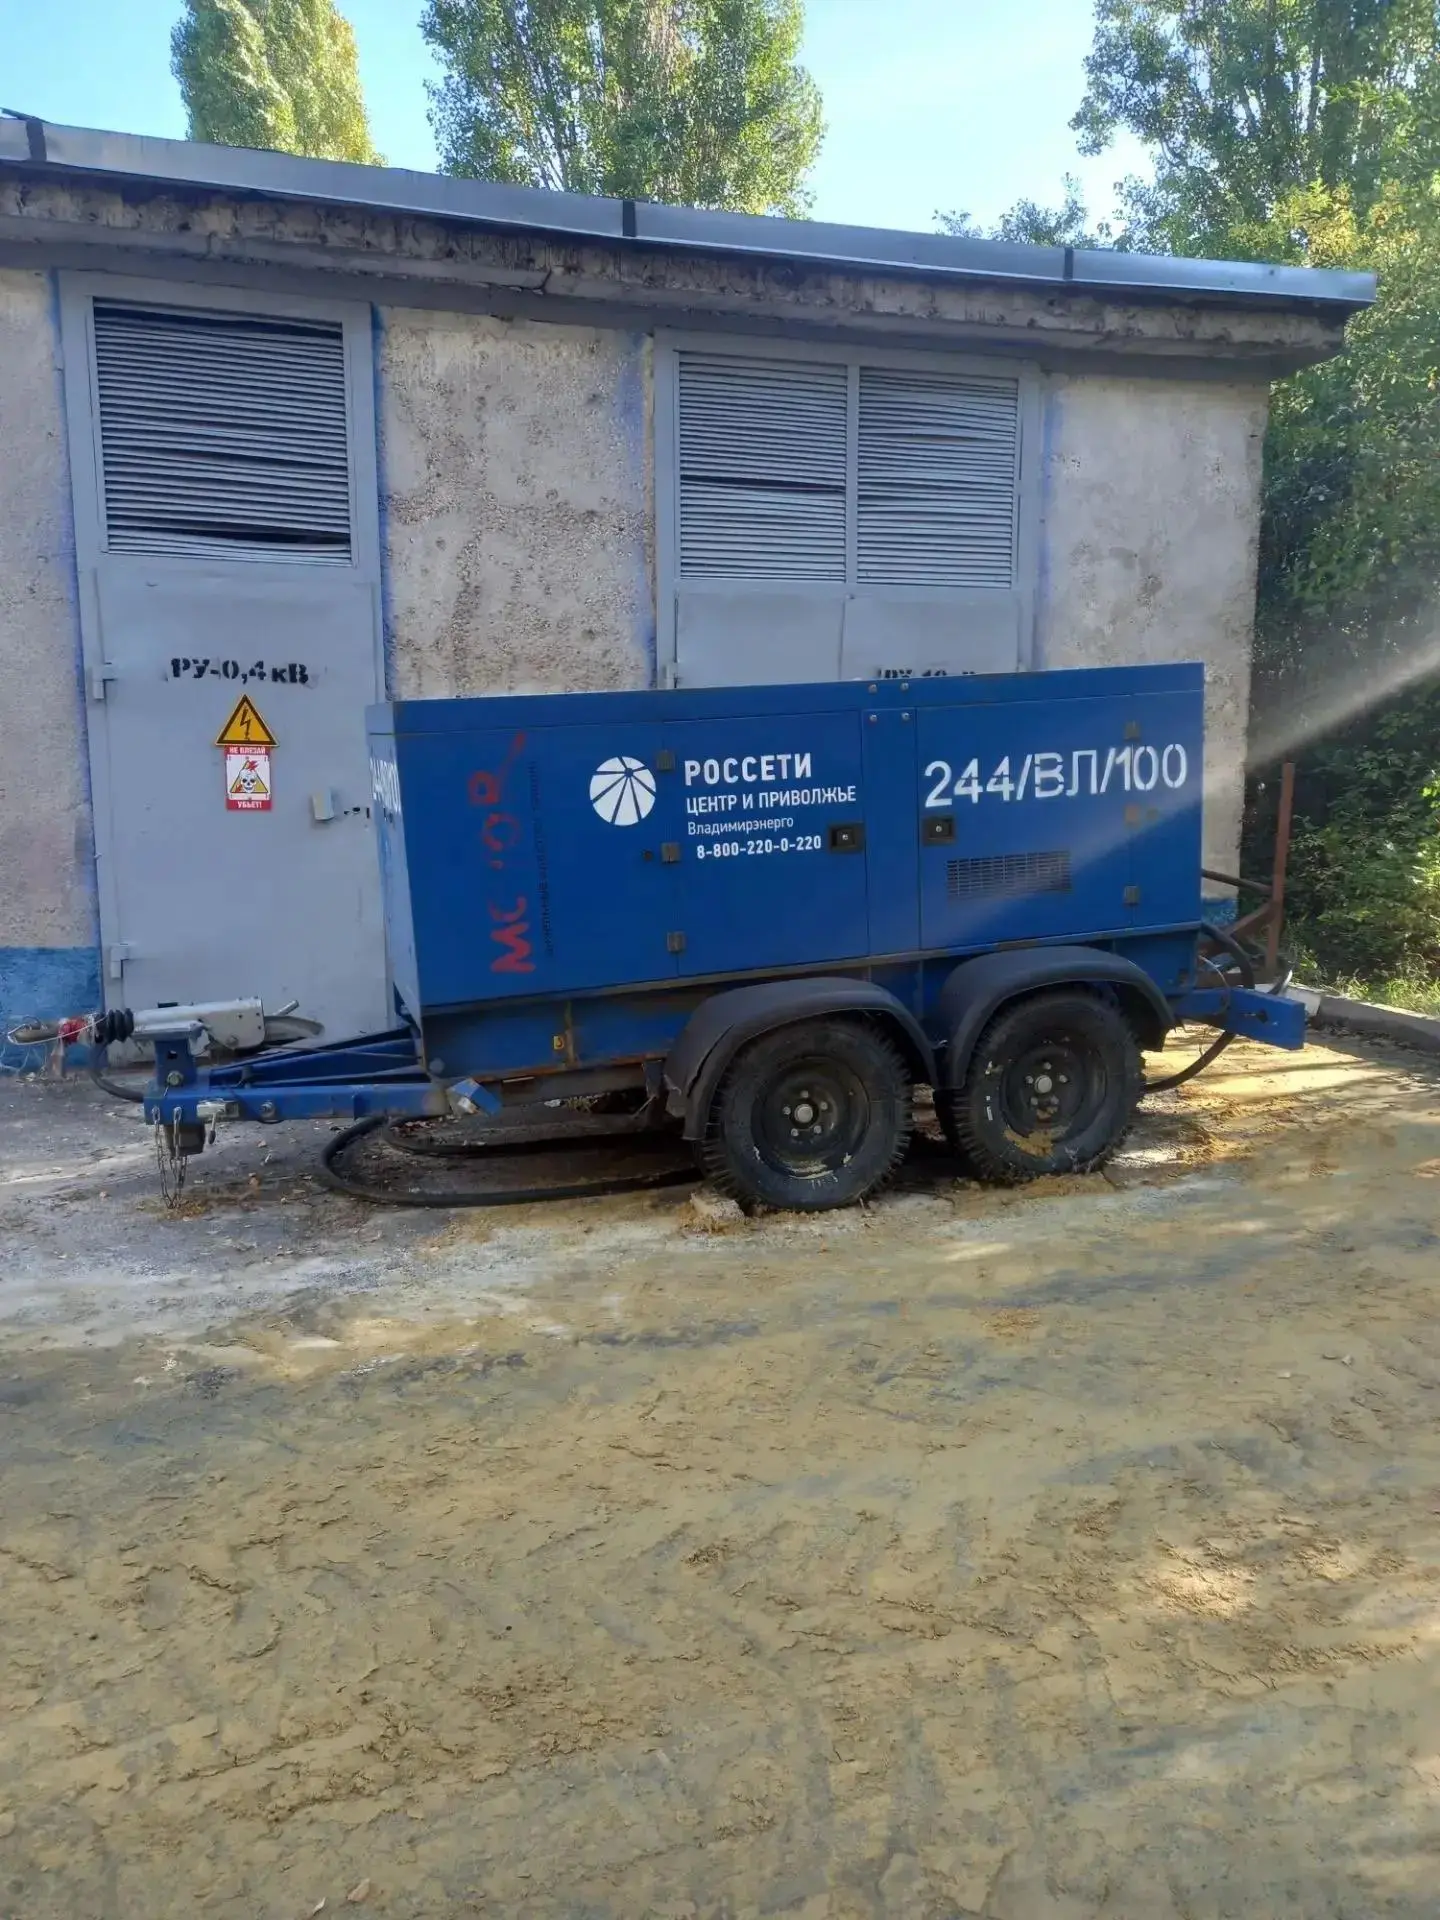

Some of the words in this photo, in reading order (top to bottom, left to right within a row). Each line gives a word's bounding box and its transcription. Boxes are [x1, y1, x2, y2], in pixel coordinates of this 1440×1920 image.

[685, 752, 812, 787] РОССЕТИ
[924, 743, 1187, 808] 244/ВЛ/100
[686, 794, 738, 817] ЦЕНТР
[742, 793, 753, 809] И
[759, 785, 857, 809] ПРИВОЛЖЬЕ
[688, 817, 794, 836] Владимирэнерго
[696, 835, 823, 860] 8-800-220-0-220
